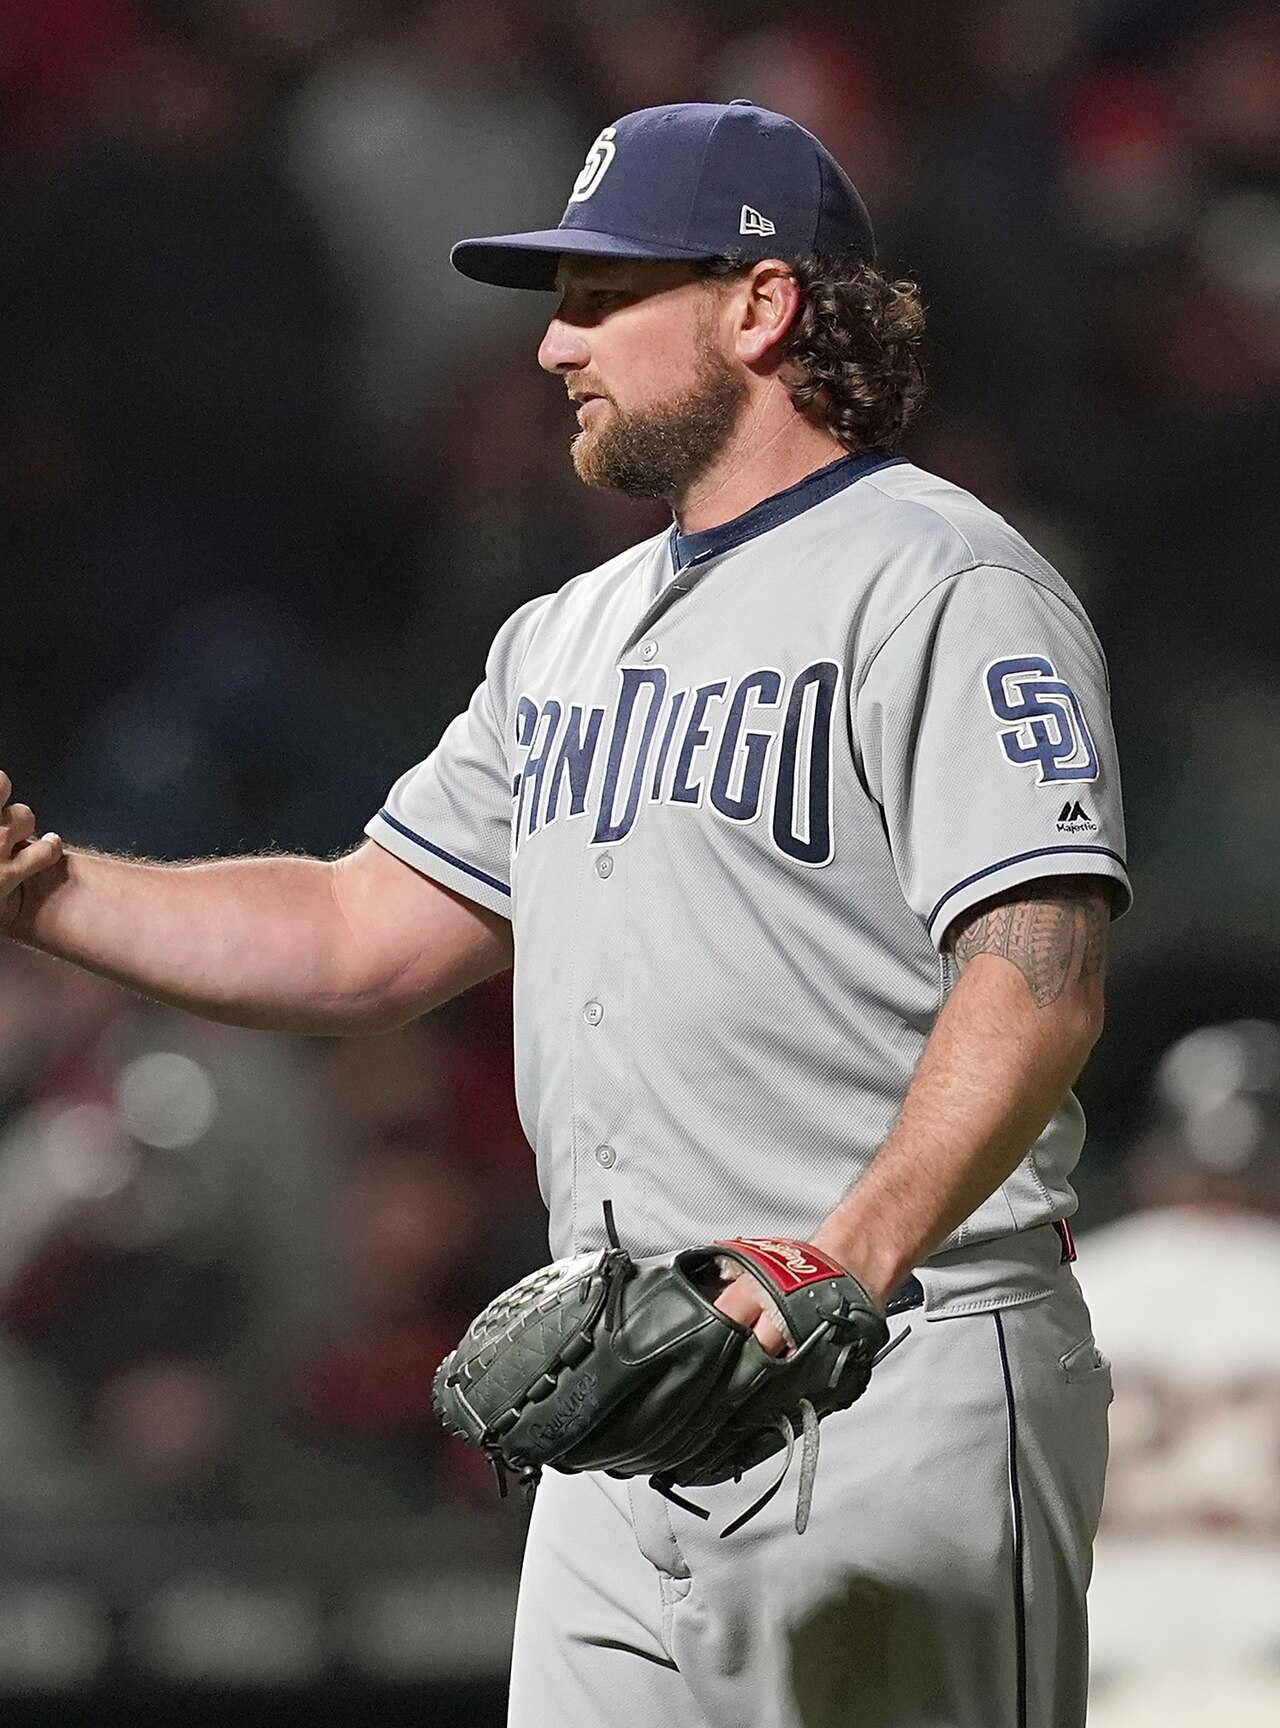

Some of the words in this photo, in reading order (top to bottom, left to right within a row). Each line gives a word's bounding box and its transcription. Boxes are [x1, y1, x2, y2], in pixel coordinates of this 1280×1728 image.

[587, 658, 843, 869] DIEGO
[983, 654, 1099, 787] SD
[1055, 821, 1098, 834] Majestic
